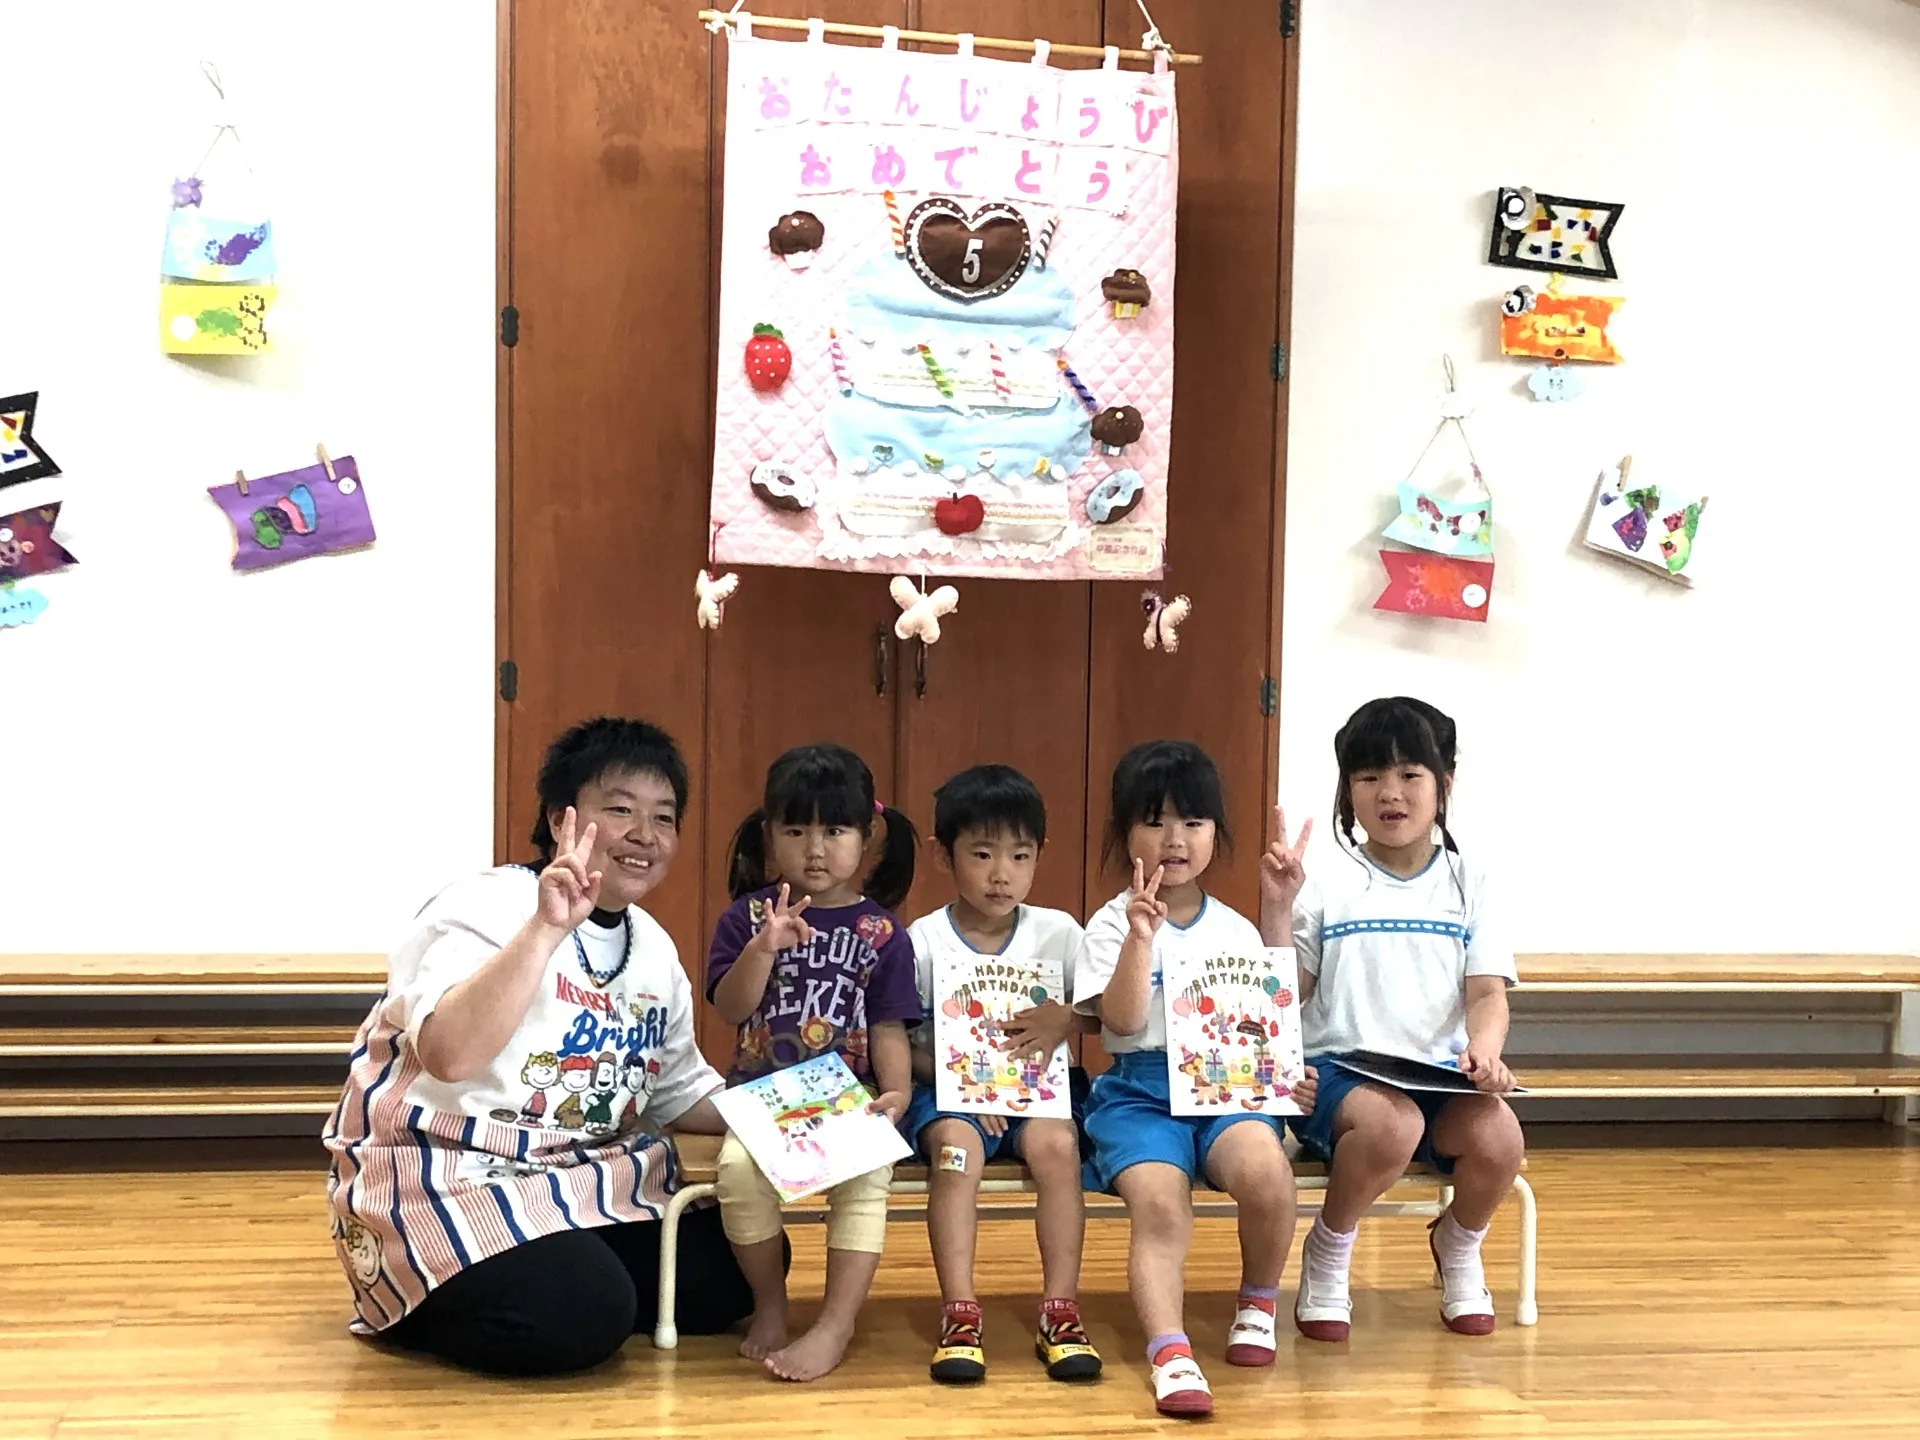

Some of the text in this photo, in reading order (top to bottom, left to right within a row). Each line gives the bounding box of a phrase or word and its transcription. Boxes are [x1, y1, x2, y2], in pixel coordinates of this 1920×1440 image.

[799, 143, 1112, 203] おめでとう
[961, 238, 985, 285] 5
[974, 964, 1026, 981] HAPPY
[1205, 956, 1257, 971] HAPPY
[556, 972, 614, 1012] MERRY
[556, 1006, 668, 1058] Bright
